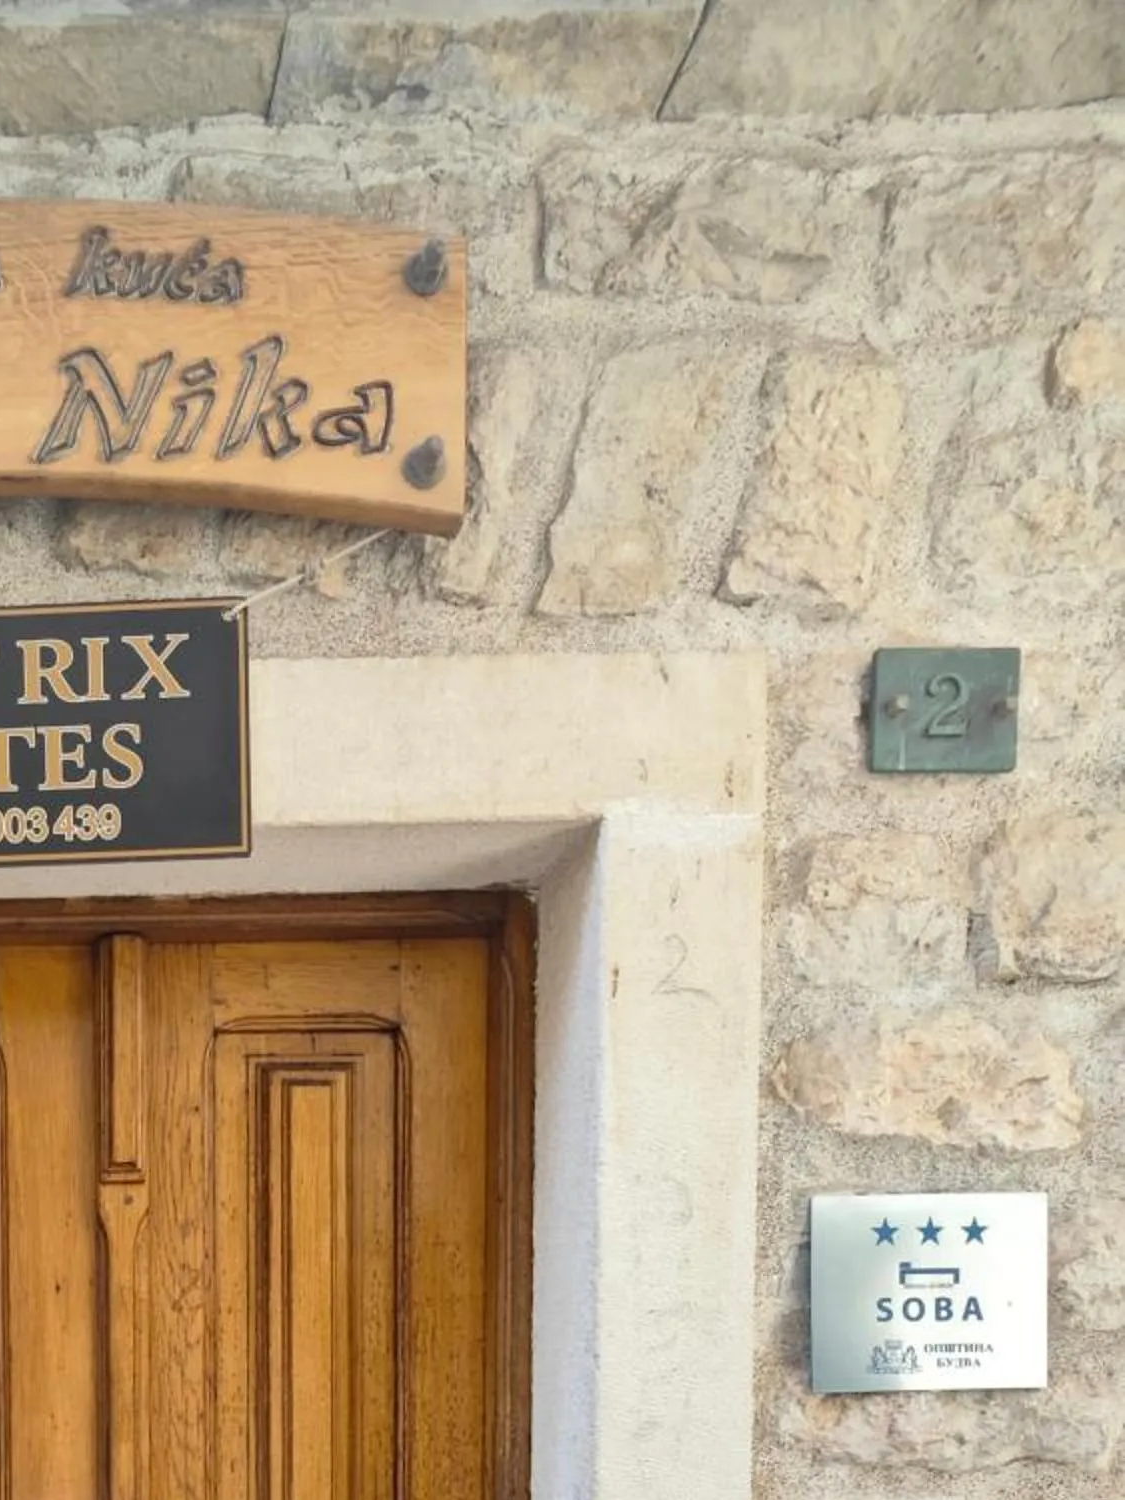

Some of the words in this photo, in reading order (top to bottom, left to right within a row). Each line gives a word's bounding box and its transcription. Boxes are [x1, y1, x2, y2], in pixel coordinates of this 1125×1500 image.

[29, 334, 395, 464] Nika
[925, 673, 970, 738] 2
[52, 803, 122, 841] 439
[876, 1296, 984, 1322] SOBA
[923, 1343, 994, 1353] ОПШТИНА
[936, 1357, 981, 1369] БУДВА
